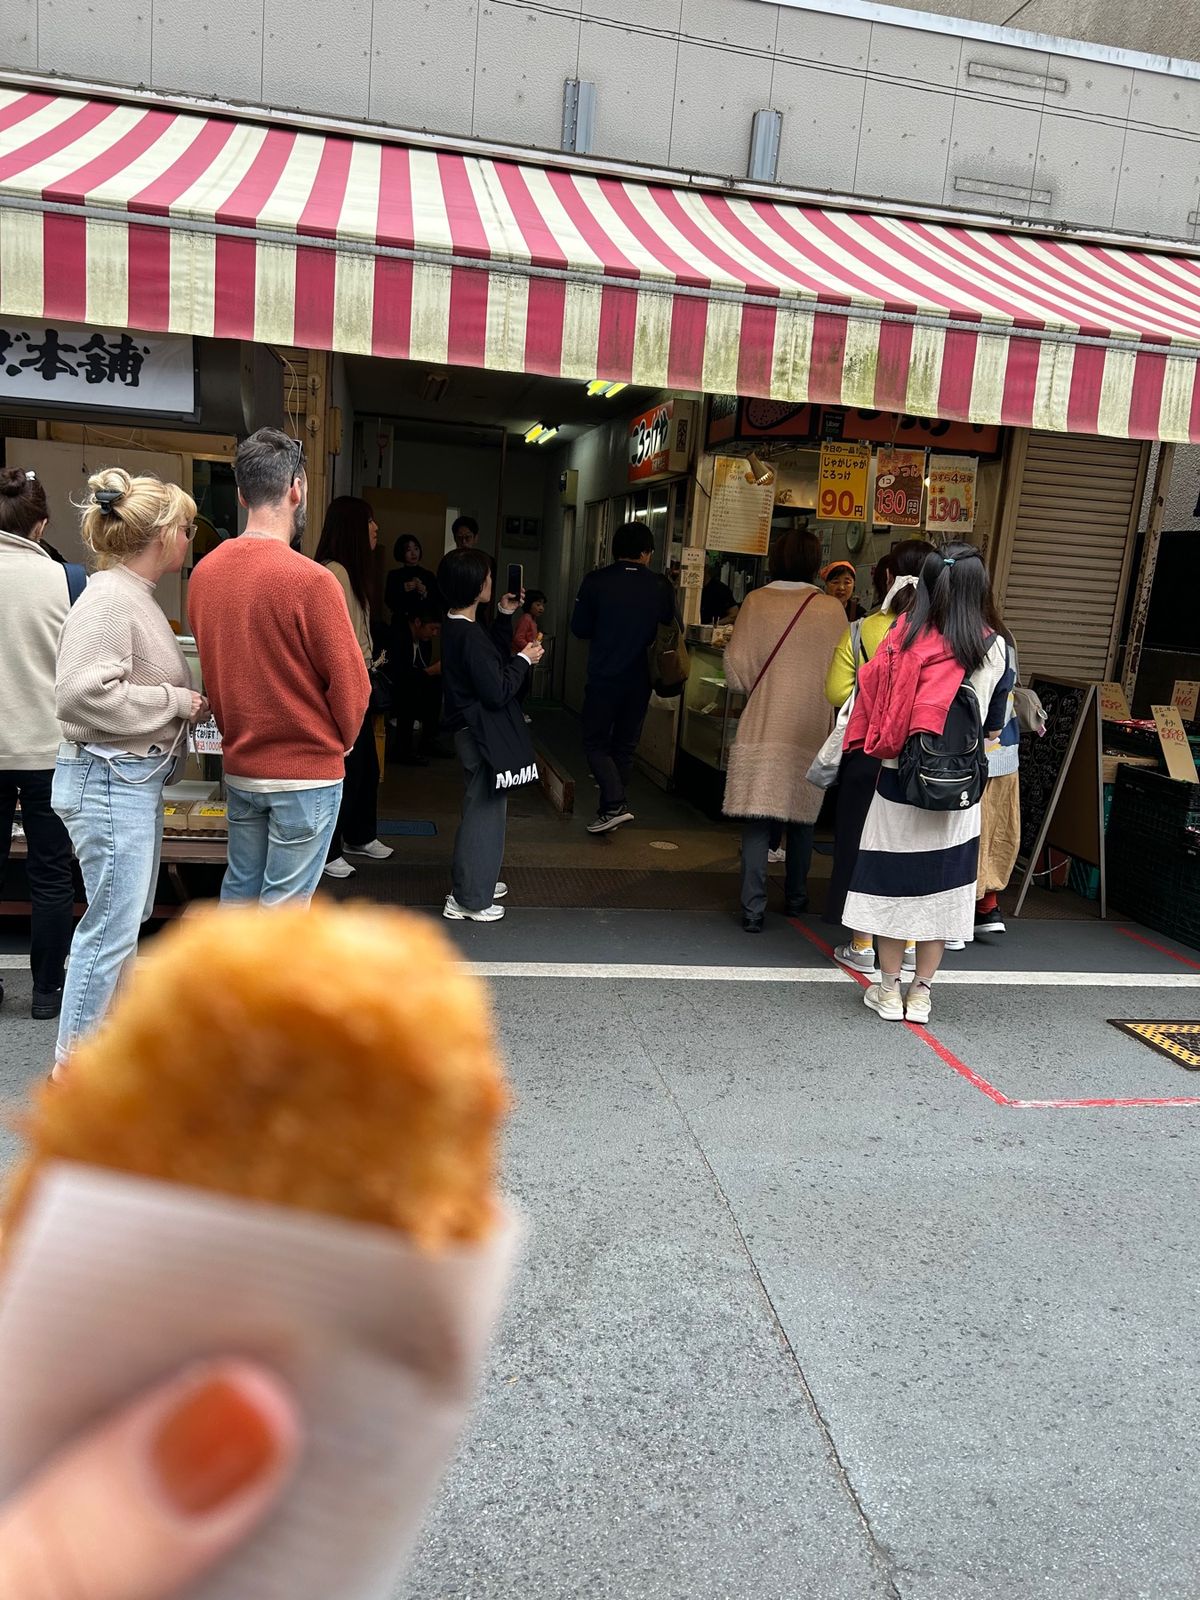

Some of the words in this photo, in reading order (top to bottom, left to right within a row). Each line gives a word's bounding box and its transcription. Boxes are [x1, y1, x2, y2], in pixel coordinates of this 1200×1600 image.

[822, 469, 851, 480] ころっけ
[823, 457, 867, 469] じゃがじゃが
[821, 489, 863, 517] 90円
[877, 489, 919, 514] 130円
[928, 497, 968, 522] 130円
[496, 763, 539, 789] MoMA
